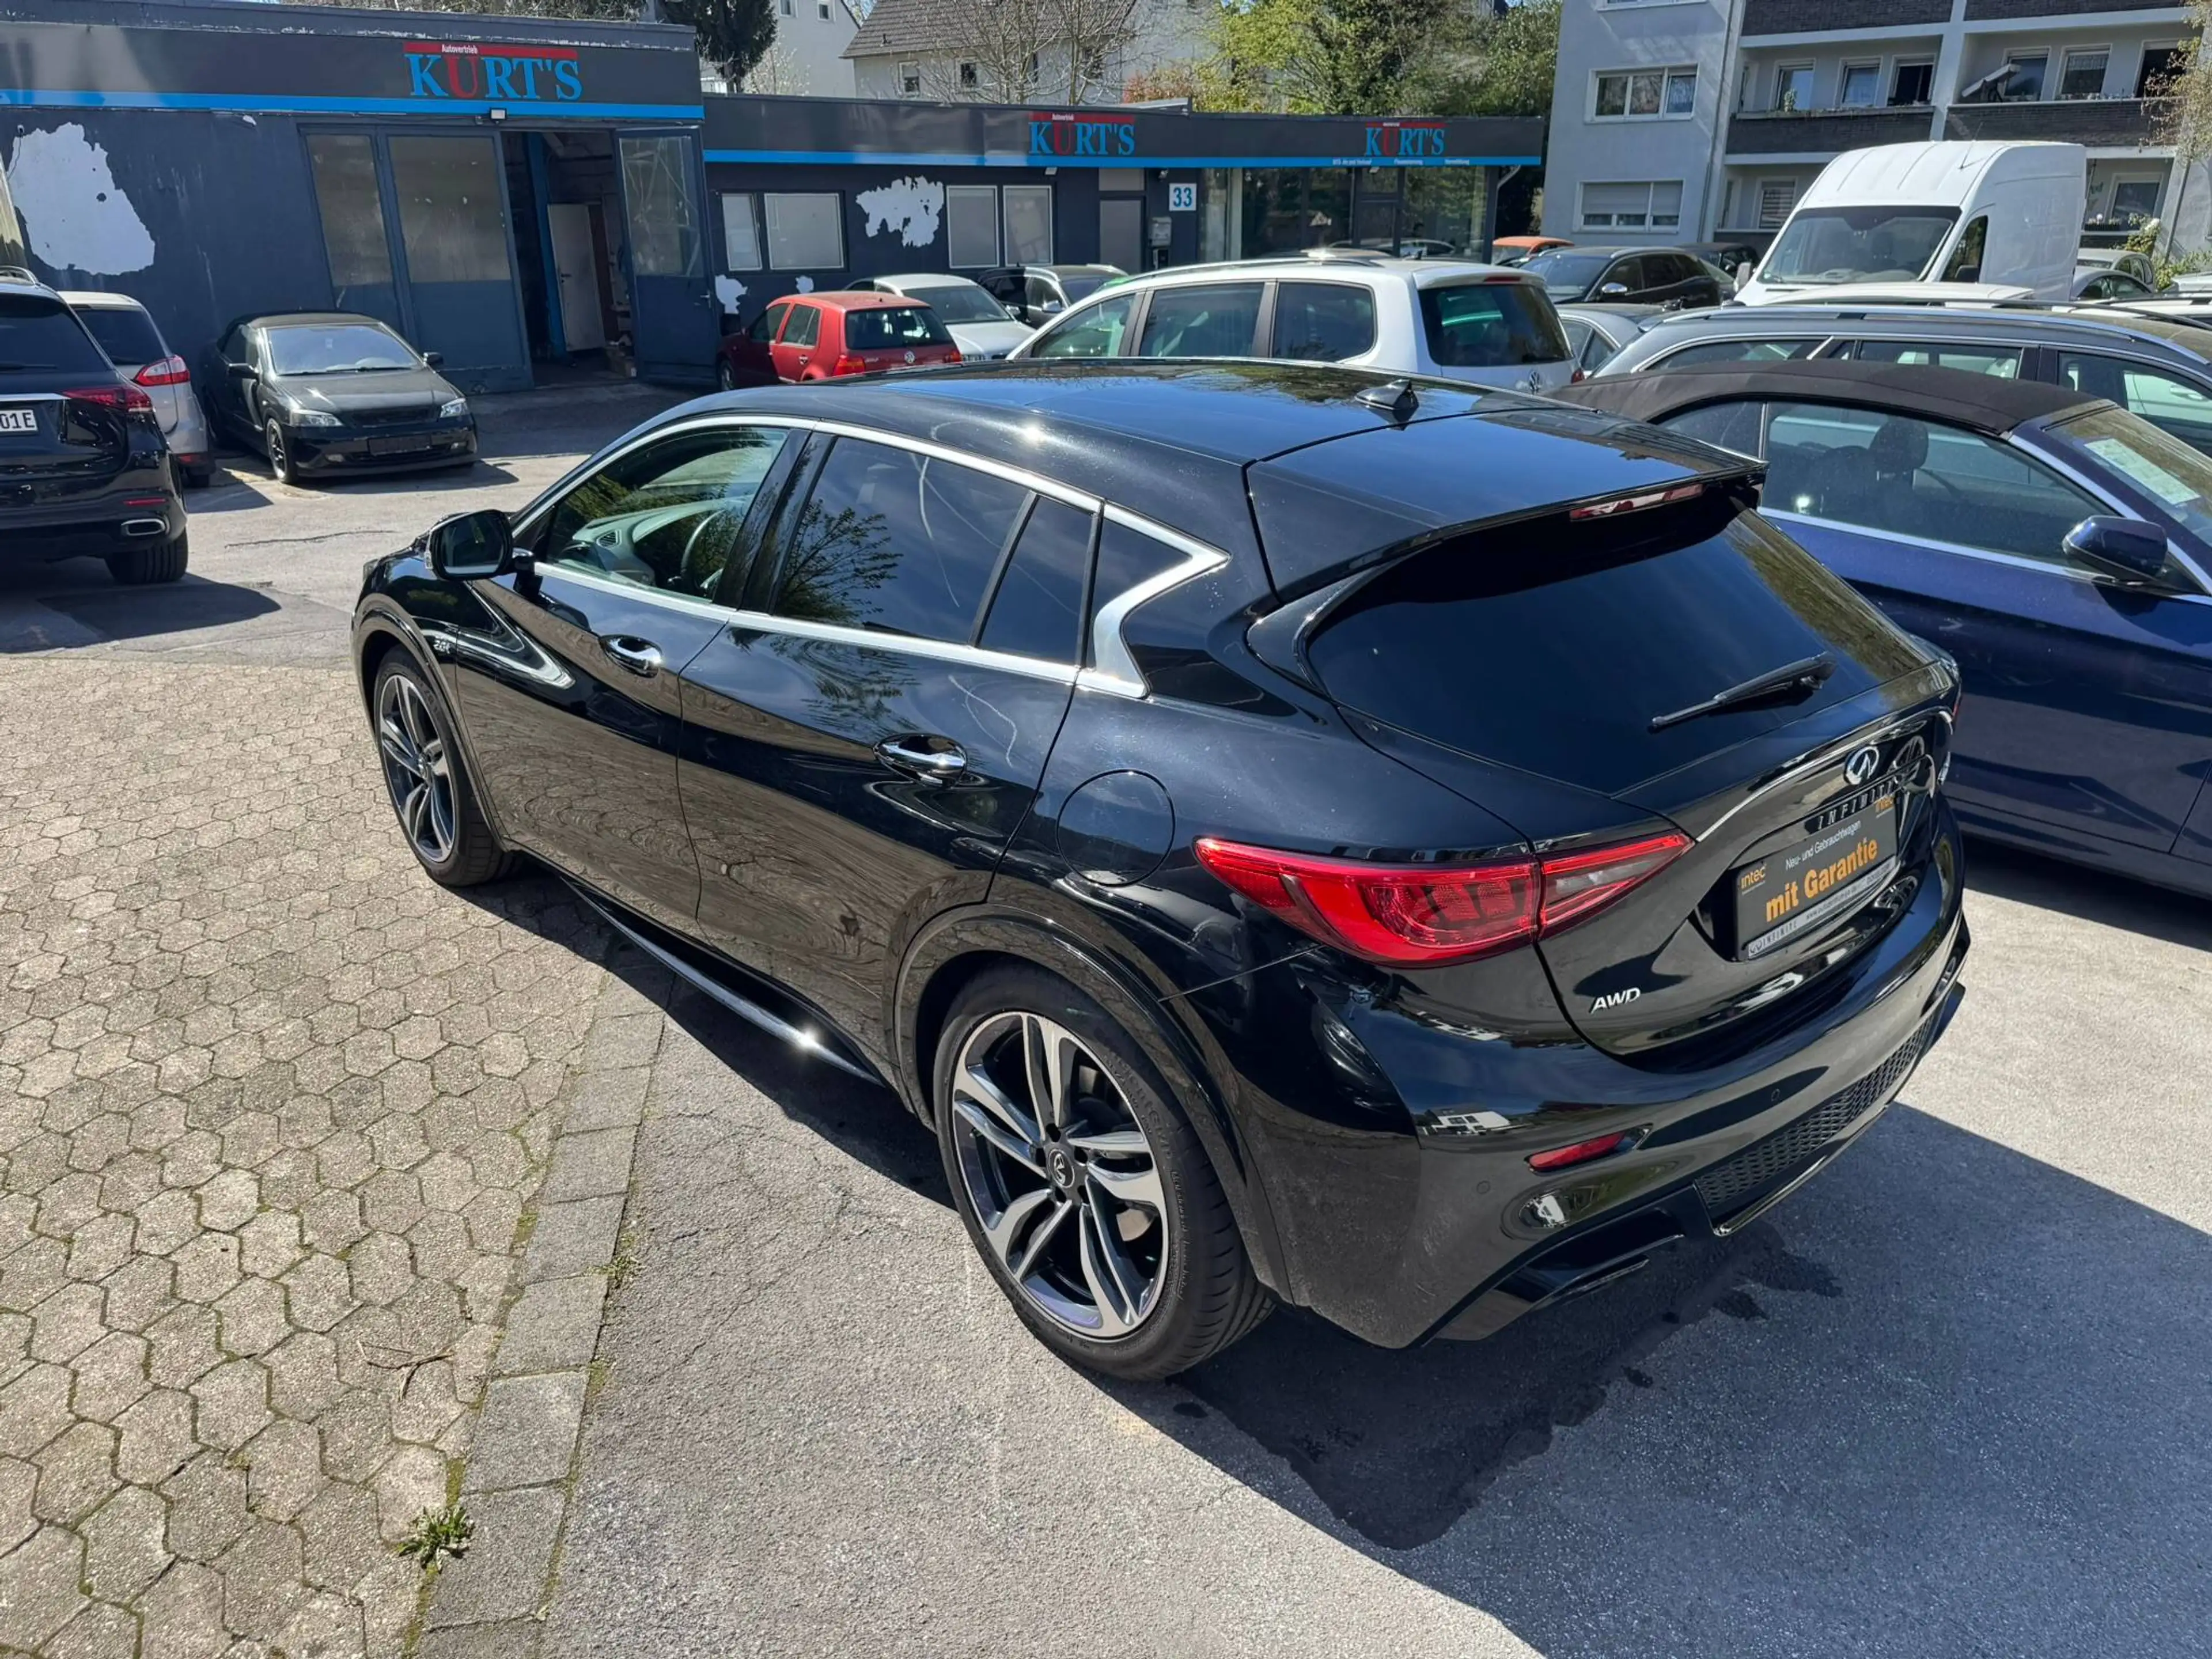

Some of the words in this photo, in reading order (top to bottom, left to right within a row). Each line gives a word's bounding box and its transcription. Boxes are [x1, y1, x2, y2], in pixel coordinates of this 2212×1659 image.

[404, 54, 583, 100] KURT'S
[1028, 122, 1135, 156] KURT'S
[1365, 127, 1445, 156] KURT'S
[1173, 186, 1192, 207] 33
[1802, 845, 1814, 861] und
[1814, 820, 1862, 854] Gebrauchtwagen
[1766, 880, 1800, 922] mit
[1804, 836, 1878, 899] Garantie
[1589, 987, 1641, 1014] AWD
